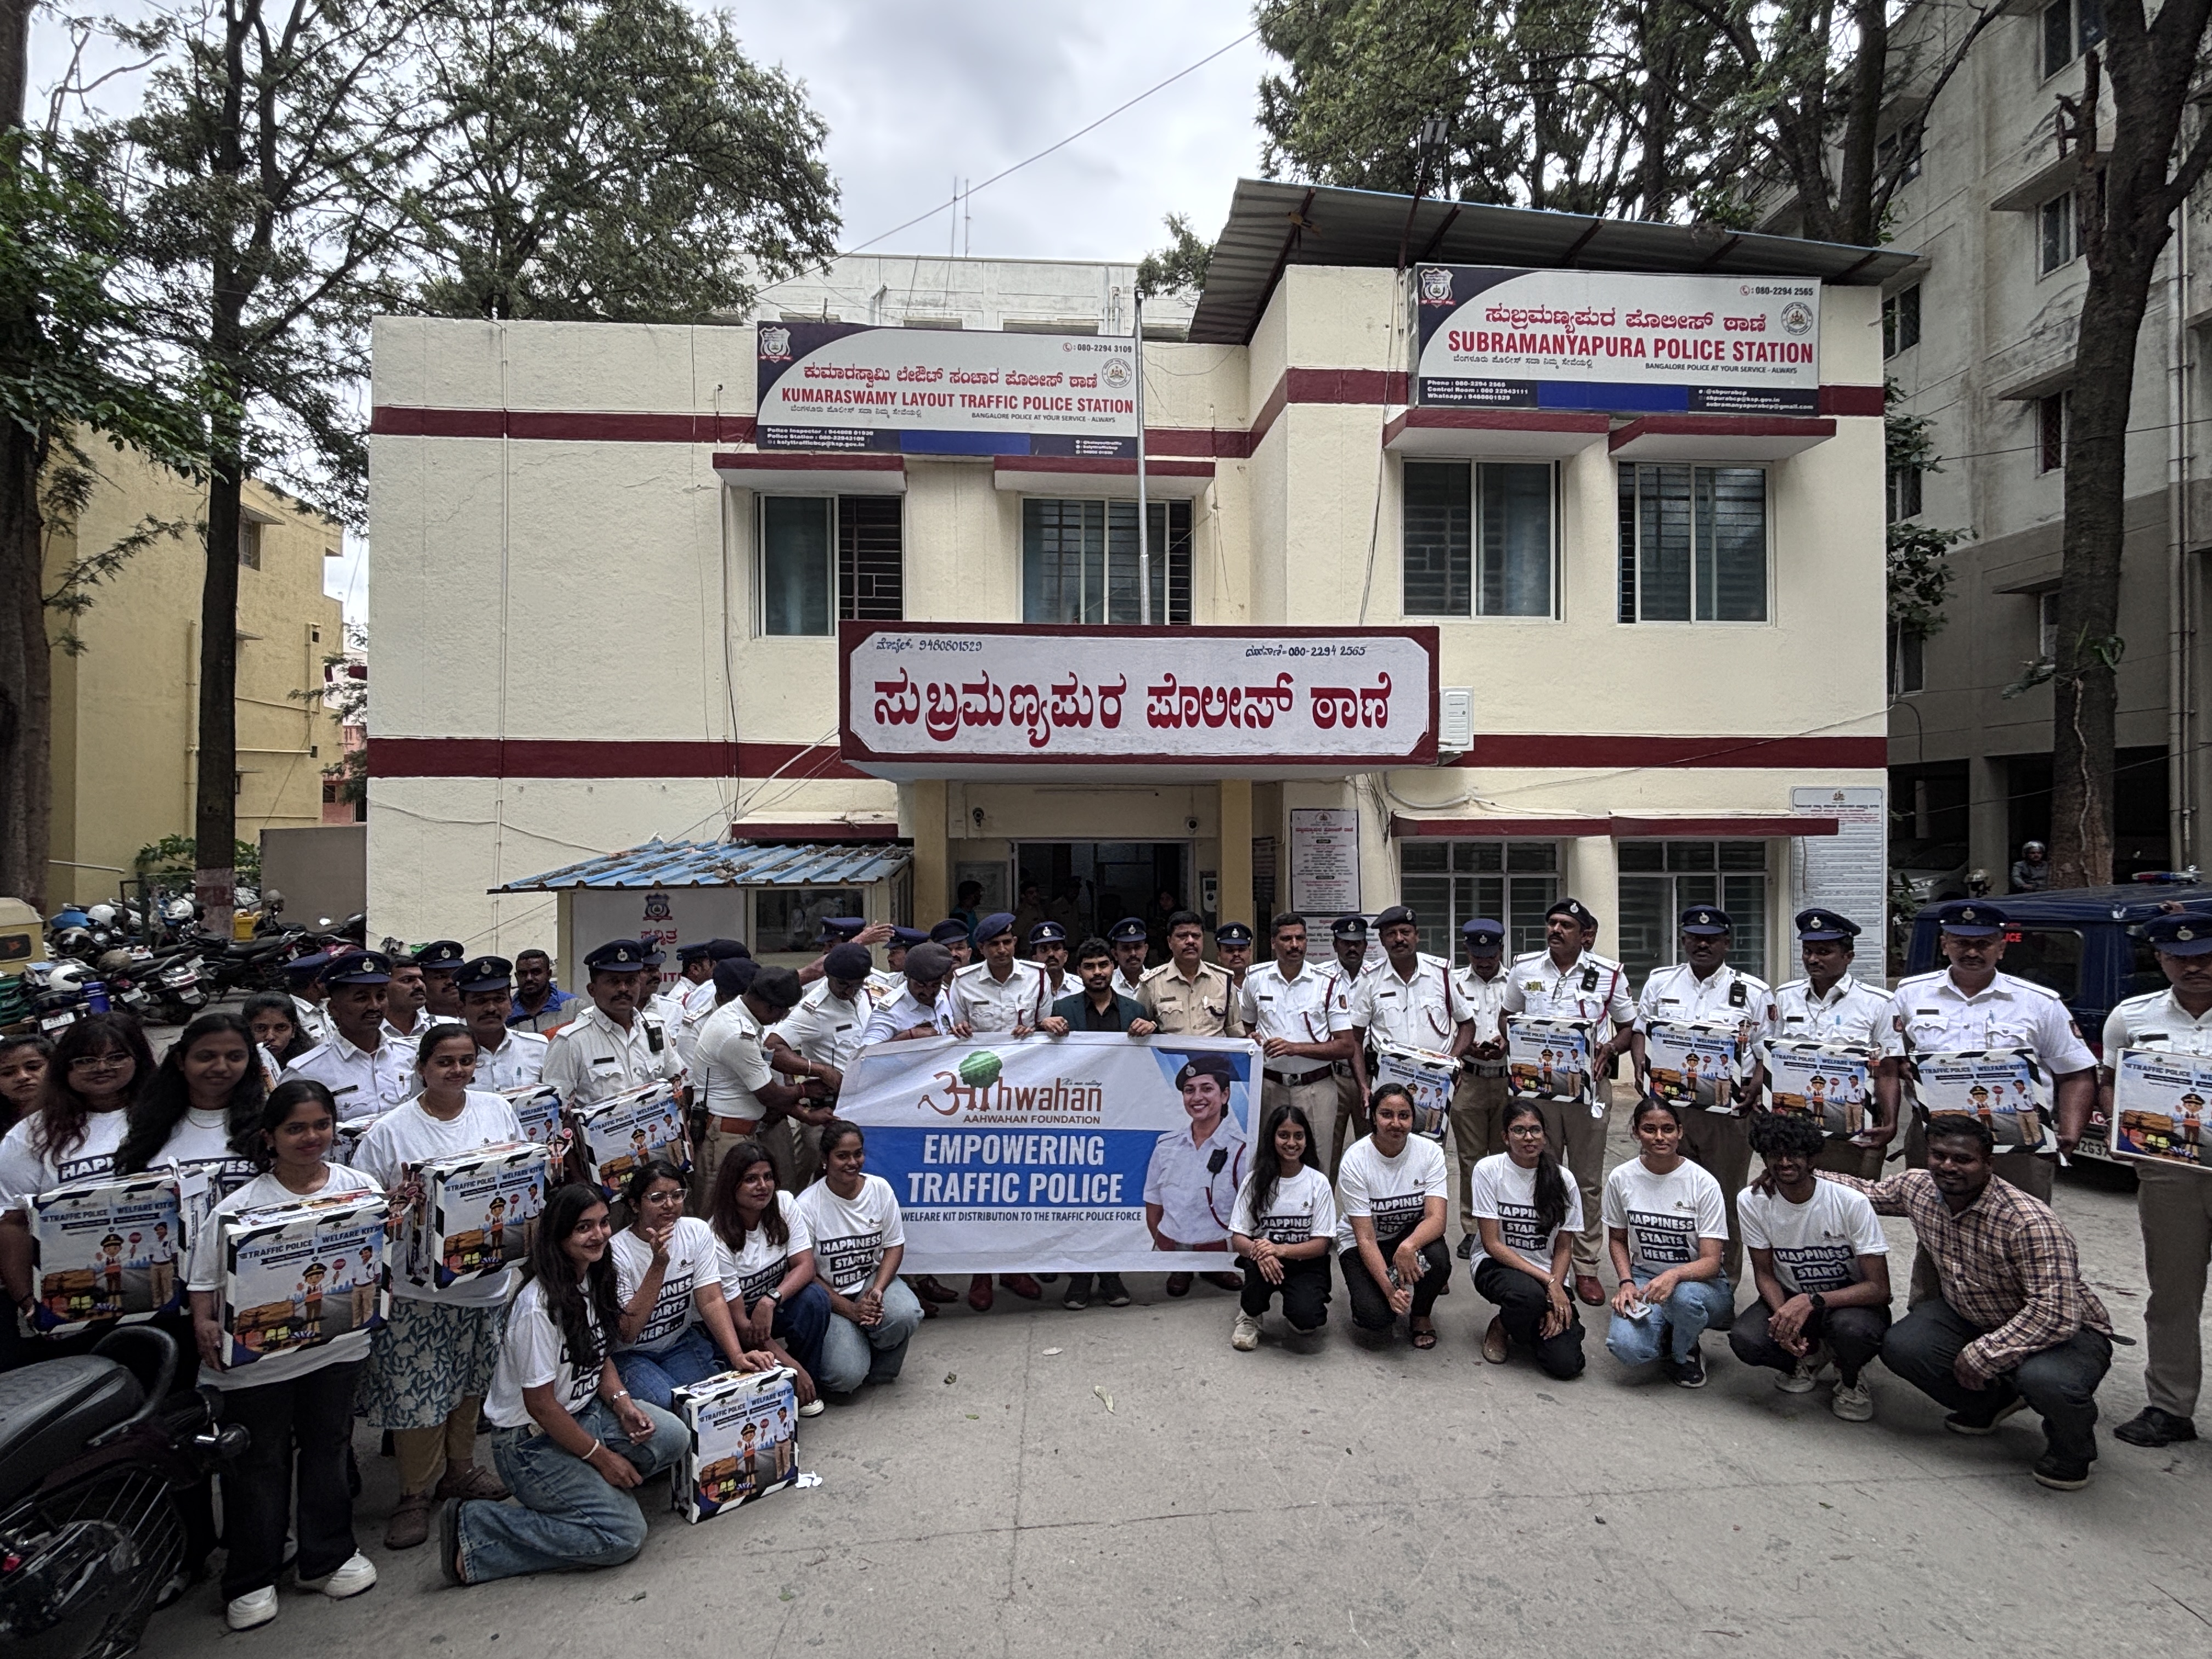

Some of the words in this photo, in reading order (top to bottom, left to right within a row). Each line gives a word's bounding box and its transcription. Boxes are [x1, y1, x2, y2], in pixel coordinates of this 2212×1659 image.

[1756, 287, 1791, 295] 080-2294
[1486, 302, 1616, 334] ಸುಬ್ರಮಣ್ಯಪುರ
[1626, 309, 1714, 329] ಪೊಲೀಸ್
[1723, 313, 1766, 332] ಠಾಣೆ
[1448, 330, 1646, 358] SUBRAMANYAPURA
[1654, 338, 1725, 360] POLICE
[1733, 341, 1813, 363] STATION
[1645, 363, 1685, 371] BANGALORE
[804, 362, 890, 388] ಕುಮಾರಸ್ವಾಮಿ
[950, 368, 999, 384] ಸಂಚಾರ
[1006, 370, 1063, 386] ಪೊಲೀಸ್
[1069, 373, 1097, 388] ಠಾಣೆ
[782, 388, 897, 405] KUMARASWAMY
[902, 392, 955, 407] LAYOUT
[960, 394, 1018, 409] TRAFFIC
[1023, 396, 1072, 411] POLICE
[1077, 397, 1133, 413] STATION
[919, 639, 982, 652] 9480801529
[1340, 645, 1367, 656] 2565
[874, 666, 1127, 748] ಸುಬ್ರಮಣ್ಯಪುರ
[1147, 672, 1294, 729] ಪೊಲೀಸ್
[1311, 672, 1392, 729] ಠಾಣೆ
[2132, 1064, 2164, 1074] TRAFFIC
[2165, 1069, 2191, 1077] POLICE
[595, 1120, 615, 1131] TRAFFIC
[963, 1115, 1029, 1124] AAHWAHAN
[1031, 1115, 1101, 1124] FOUNDATION
[923, 1135, 1105, 1165] EMPOWERING
[502, 1169, 528, 1180] WELFARE
[451, 1181, 476, 1192] TRAFFIC
[477, 1176, 496, 1186] POLICE
[908, 1172, 1020, 1203] TRAFFIC
[1029, 1173, 1124, 1203] POLICE
[117, 1204, 153, 1214] WELFARE
[1370, 1195, 1424, 1211] HAPPINES
[49, 1212, 81, 1222] TRAFFIC
[83, 1209, 108, 1218] POLICE
[901, 1212, 940, 1222] WELFARE
[943, 1212, 956, 1221] KIT
[958, 1211, 1019, 1221] DISTRIBUTION
[1020, 1211, 1031, 1221] TO
[1034, 1211, 1049, 1221] THE
[1052, 1211, 1084, 1221] TRAFFIC
[1086, 1211, 1114, 1222] POLICE
[1115, 1211, 1141, 1222] FORCE
[1628, 1213, 1694, 1230] HAPPINESS
[1507, 1223, 1536, 1233] STAR
[322, 1231, 360, 1243] WELFARE
[822, 1234, 881, 1253] HAPPINESS
[1273, 1233, 1310, 1243] STARTS
[1641, 1232, 1684, 1245] STARTS
[249, 1245, 284, 1259] TRAFFIC
[285, 1239, 313, 1251] POLICE
[1643, 1249, 1689, 1261] HERE...
[1777, 1248, 1850, 1262] HAPPINESS
[835, 1252, 872, 1268] STARTS
[835, 1270, 871, 1285] HERE...
[1797, 1264, 1844, 1278] STARTS
[639, 1322, 682, 1342] HERE...
[751, 1392, 777, 1406] WELFARE
[705, 1408, 727, 1421] TRAFFIC
[728, 1402, 746, 1414] POLICE
